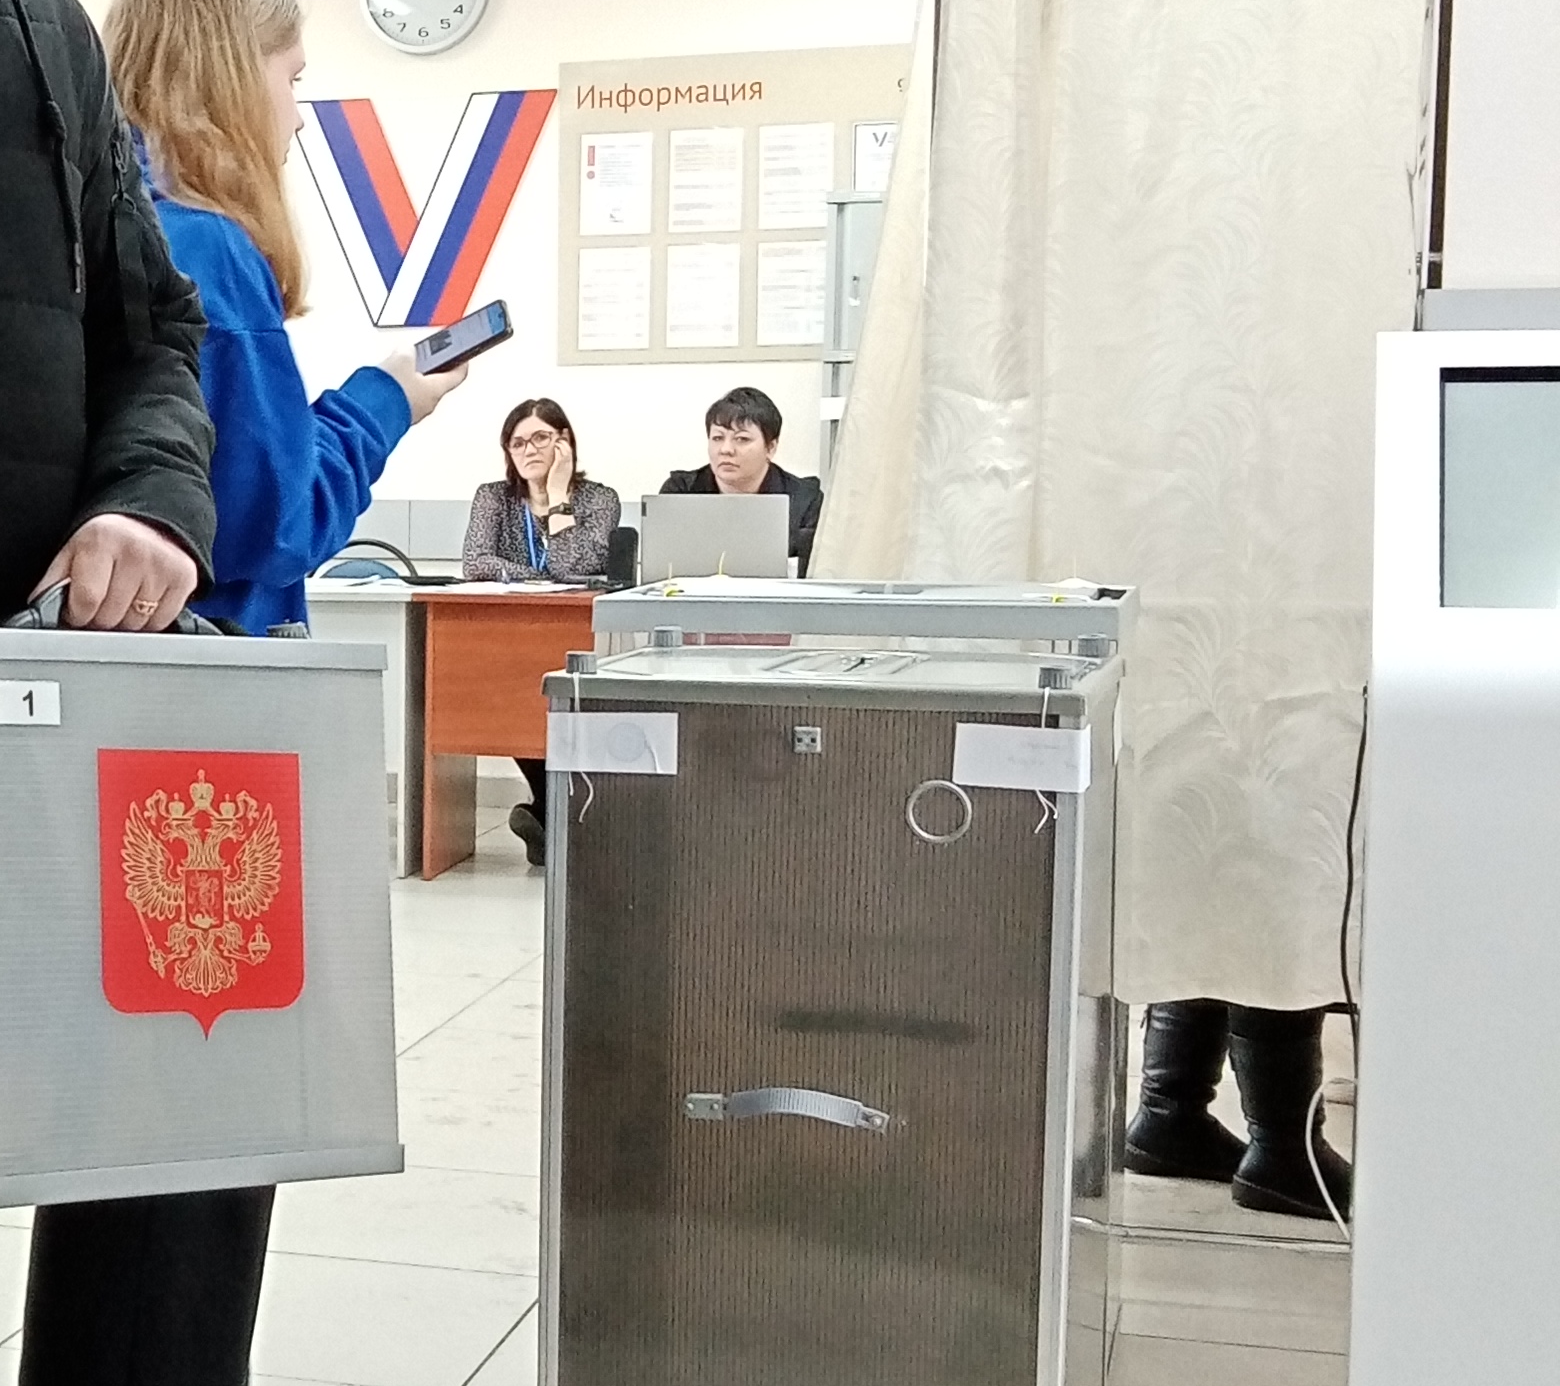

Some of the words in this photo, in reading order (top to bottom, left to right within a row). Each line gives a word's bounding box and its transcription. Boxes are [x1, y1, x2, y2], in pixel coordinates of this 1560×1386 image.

[453, 4, 464, 14] 4
[397, 22, 407, 33] 7
[440, 18, 451, 30] 5
[418, 27, 429, 38] 6
[577, 81, 763, 114] Информация
[22, 689, 34, 717] 1
